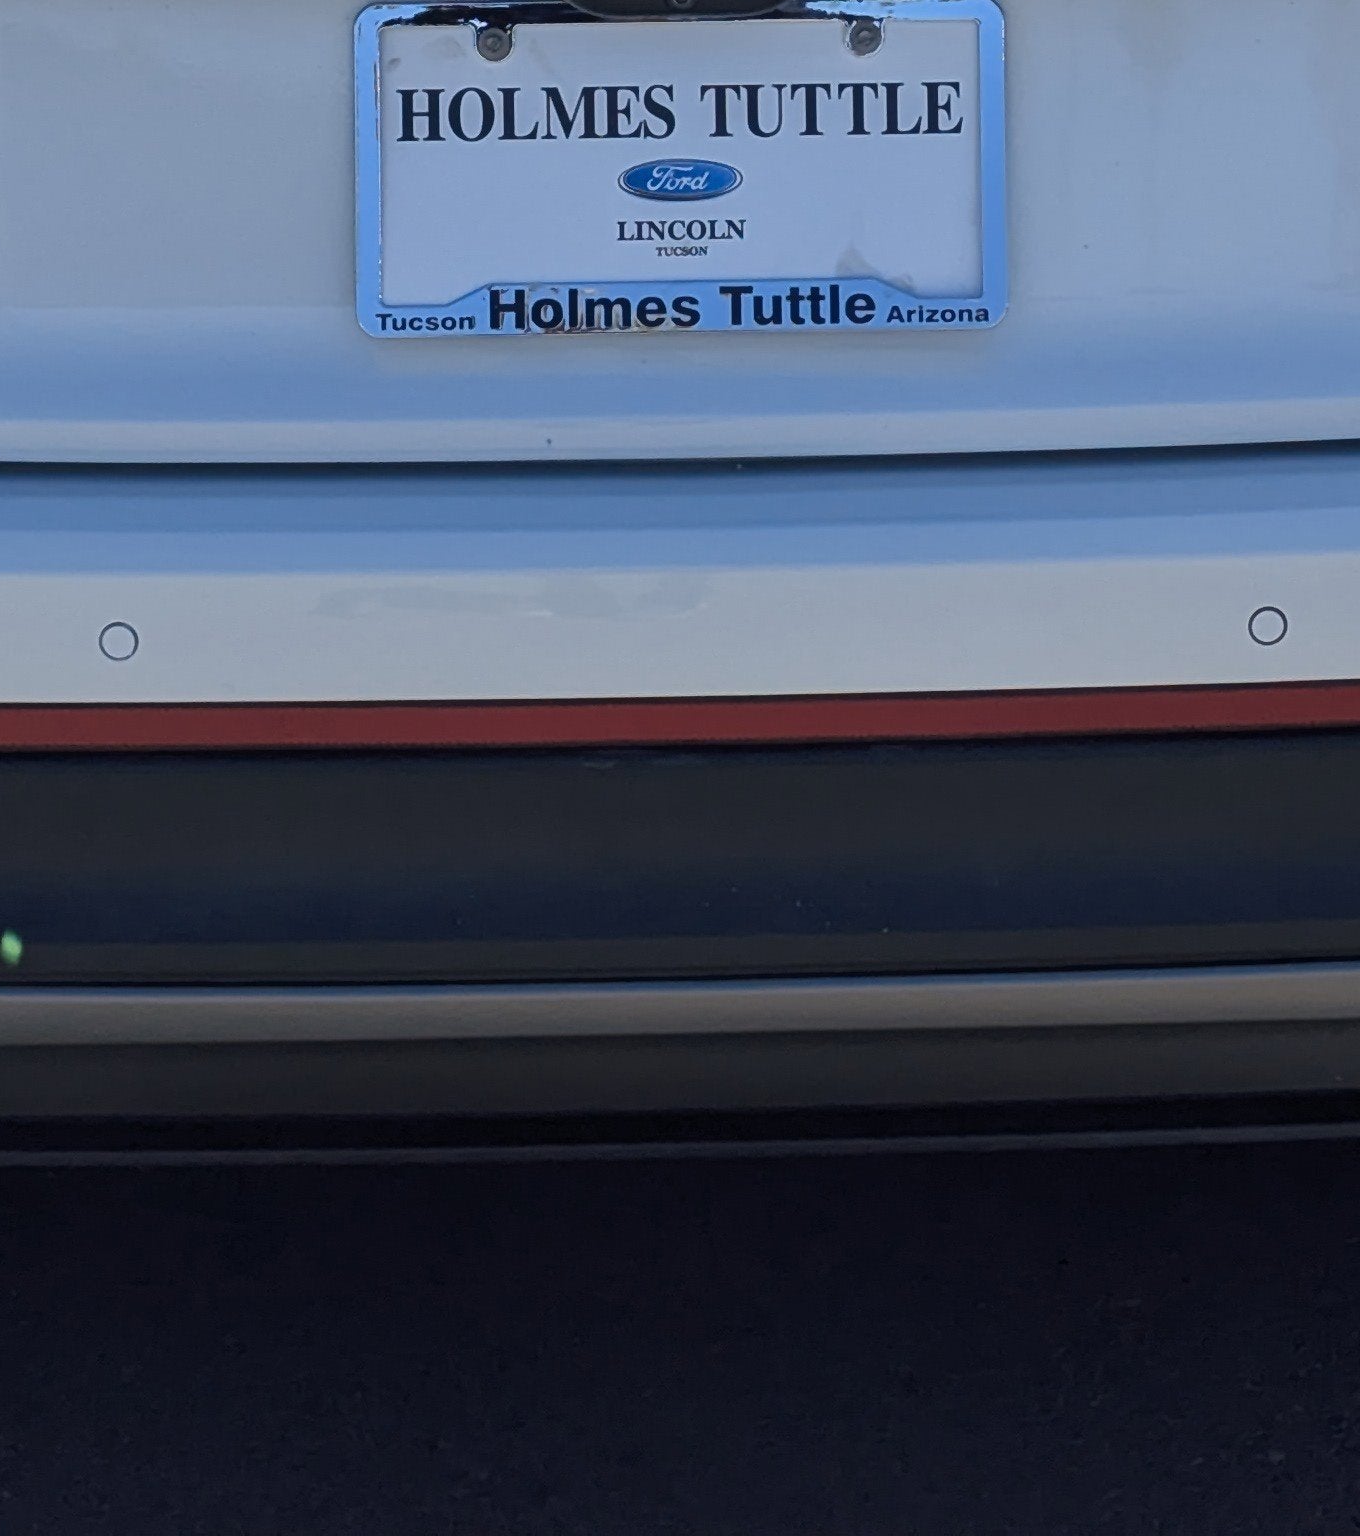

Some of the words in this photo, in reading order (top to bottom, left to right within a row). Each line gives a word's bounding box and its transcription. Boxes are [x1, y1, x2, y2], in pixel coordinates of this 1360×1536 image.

[396, 85, 676, 142] HOLMES
[700, 81, 964, 137] TUTTLE
[646, 164, 710, 192] Ford
[617, 219, 746, 242] LINCOLN
[656, 245, 708, 257] TUCSON
[376, 313, 474, 331] Tucson
[489, 288, 701, 330] Holmes
[719, 284, 876, 326] Tuttle
[886, 305, 989, 323] Arizona
